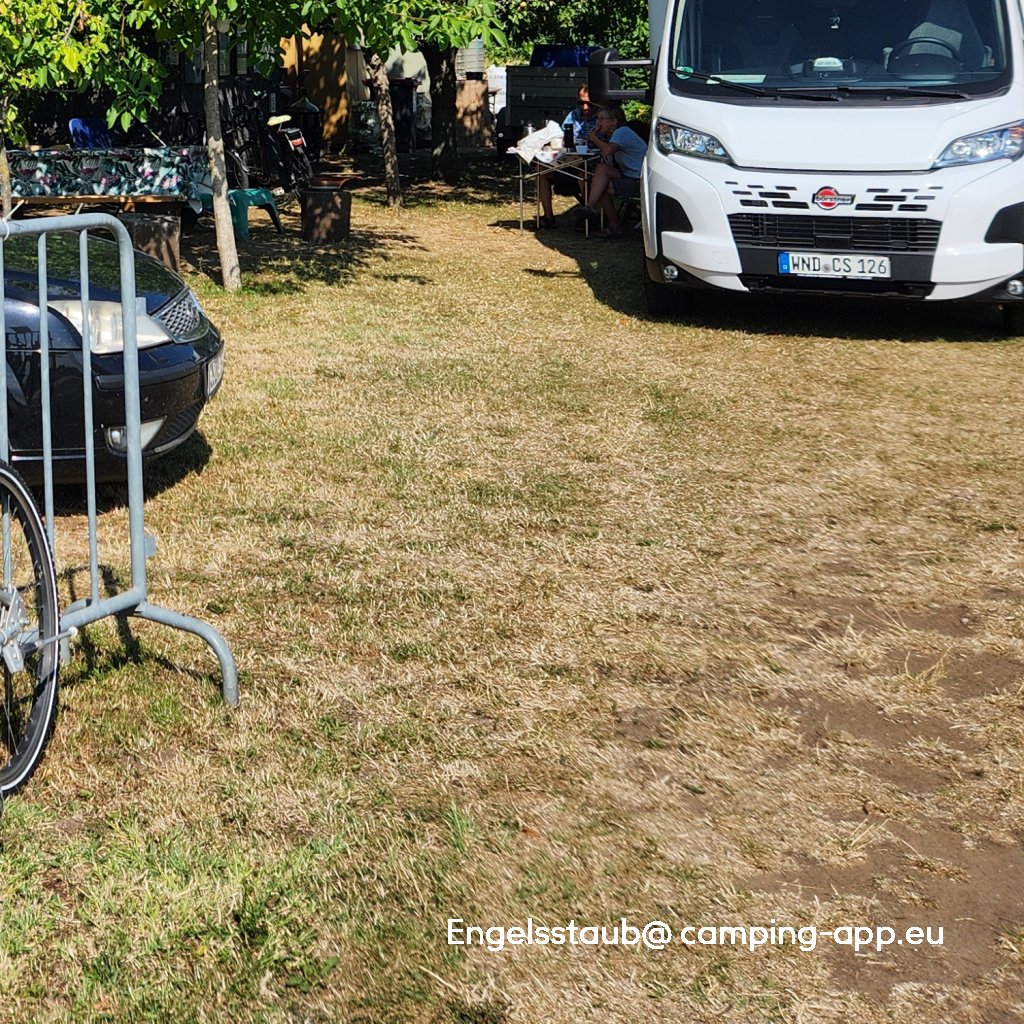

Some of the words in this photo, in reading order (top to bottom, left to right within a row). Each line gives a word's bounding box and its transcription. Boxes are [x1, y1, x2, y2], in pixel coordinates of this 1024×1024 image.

[791, 256, 821, 272] WND
[832, 257, 852, 273] CS
[857, 258, 887, 275] 126
